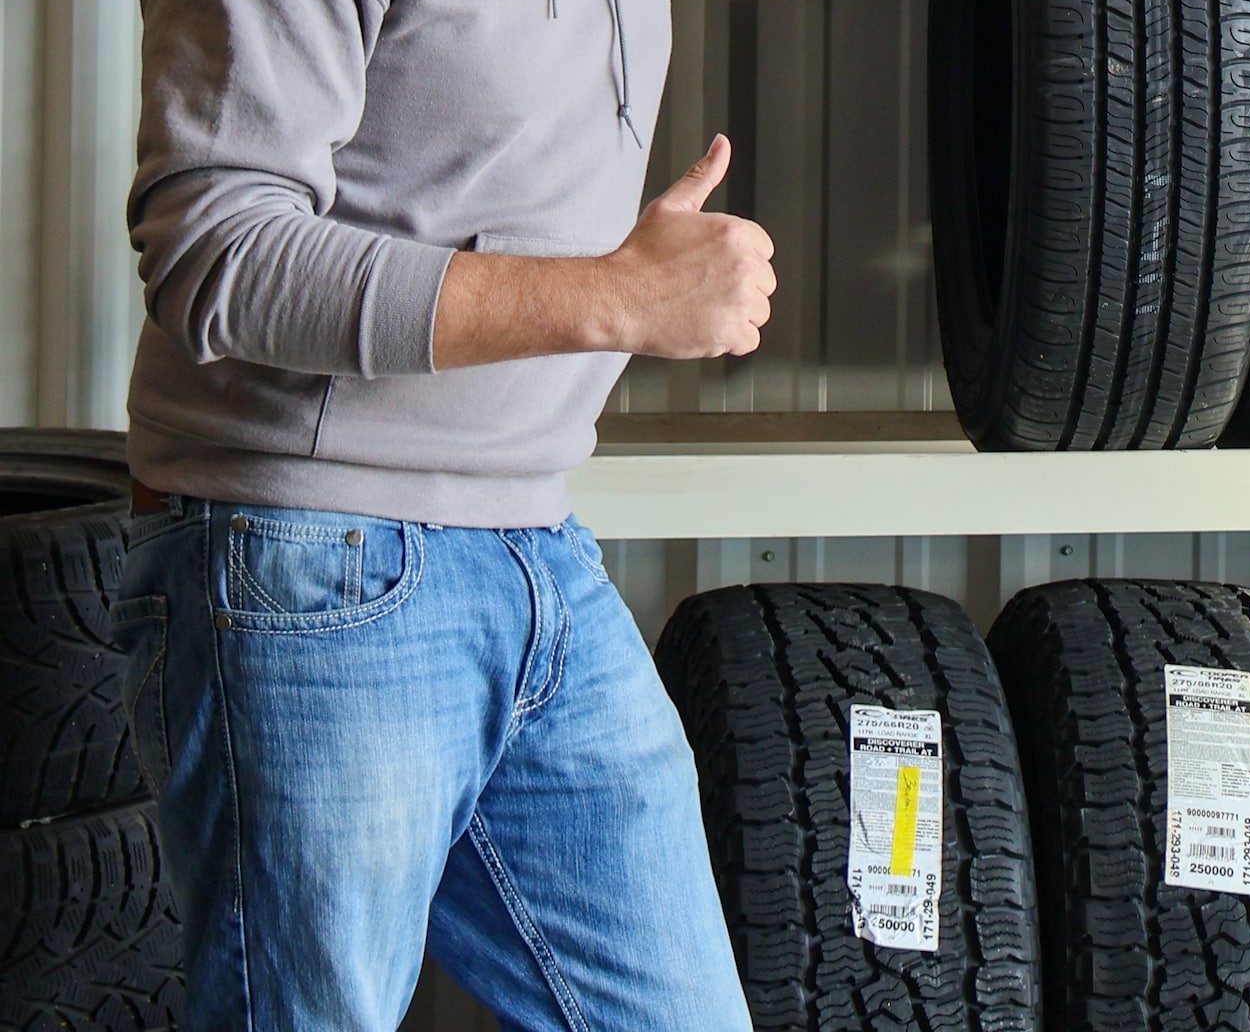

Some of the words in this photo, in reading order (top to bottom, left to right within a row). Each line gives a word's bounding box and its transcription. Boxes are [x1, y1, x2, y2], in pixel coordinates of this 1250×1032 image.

[1176, 700, 1200, 709] ROAD
[1209, 703, 1231, 712] TRAIL
[1183, 696, 1238, 706] DISCOVERER
[860, 744, 885, 752] ROAD
[895, 747, 919, 755] TRAIL
[867, 739, 924, 748] DISCOVERER
[1187, 808, 1239, 821] 90000097771
[1170, 810, 1182, 878] 171-293-049
[1190, 863, 1234, 877] 250000
